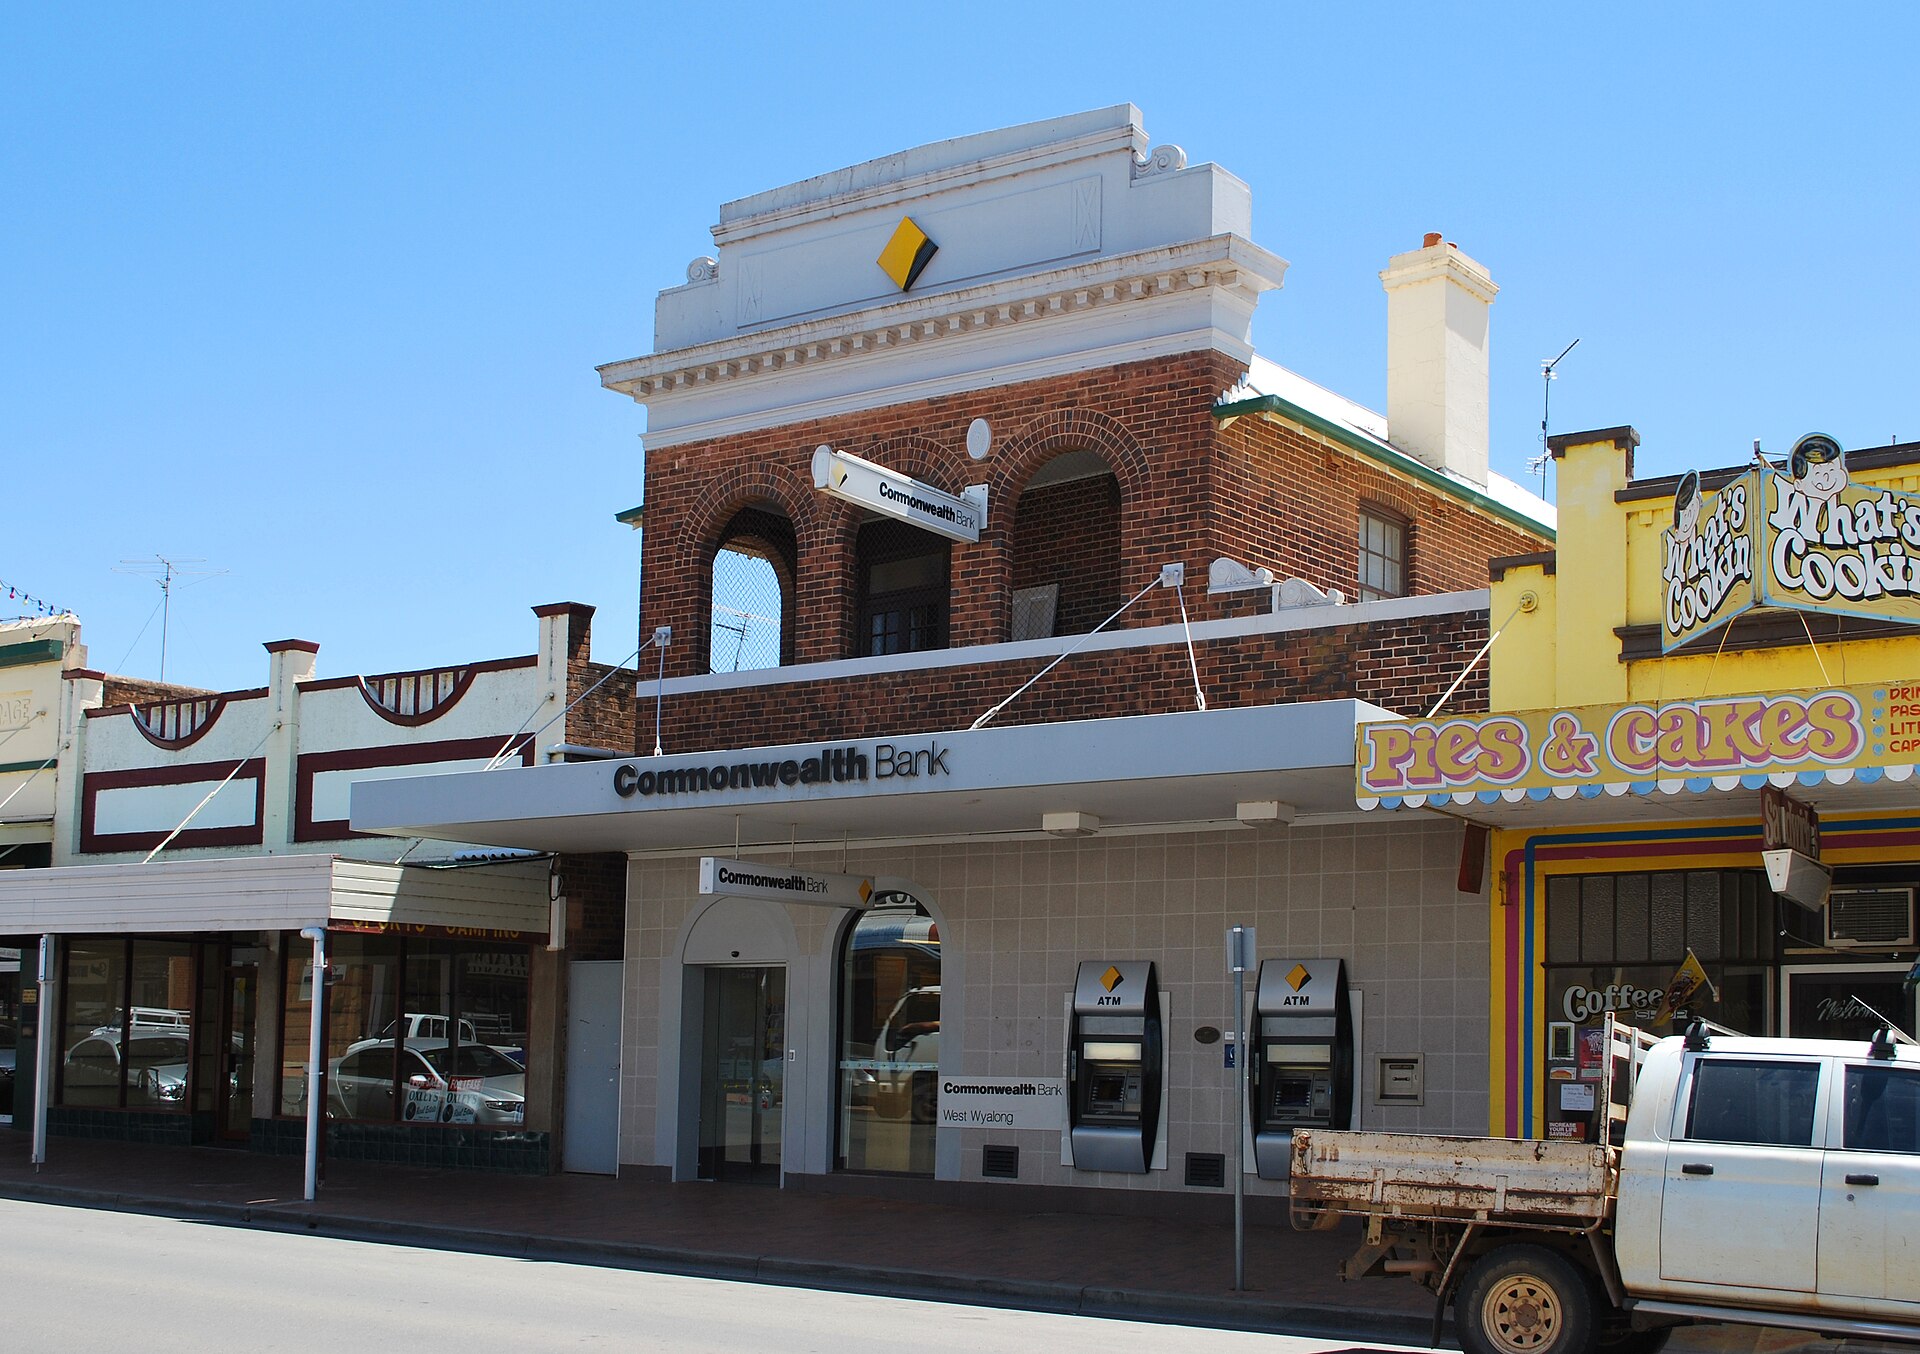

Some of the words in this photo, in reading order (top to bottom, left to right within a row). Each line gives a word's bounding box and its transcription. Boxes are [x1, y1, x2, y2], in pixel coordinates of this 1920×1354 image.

[879, 481, 955, 524] Commonwealth
[955, 509, 976, 531] Bank
[1767, 473, 1920, 549] What's
[1664, 483, 1746, 585] What's
[1667, 534, 1752, 634] Cookin
[613, 747, 867, 798] Commonwealth
[874, 741, 949, 778] Bank
[1364, 720, 1529, 788] Pies
[1542, 716, 1595, 774] &
[718, 867, 806, 892] Commonwealth
[806, 877, 828, 894] Bank
[1097, 996, 1121, 1006] ATM
[1283, 996, 1310, 1006] ATM
[1563, 984, 1664, 1023] Coffee
[1817, 998, 1889, 1021] Welcom
[944, 1082, 1036, 1095] Commonwealth
[1038, 1084, 1062, 1096] Bank
[943, 1109, 967, 1122] West
[971, 1110, 1014, 1126] Wyalong
